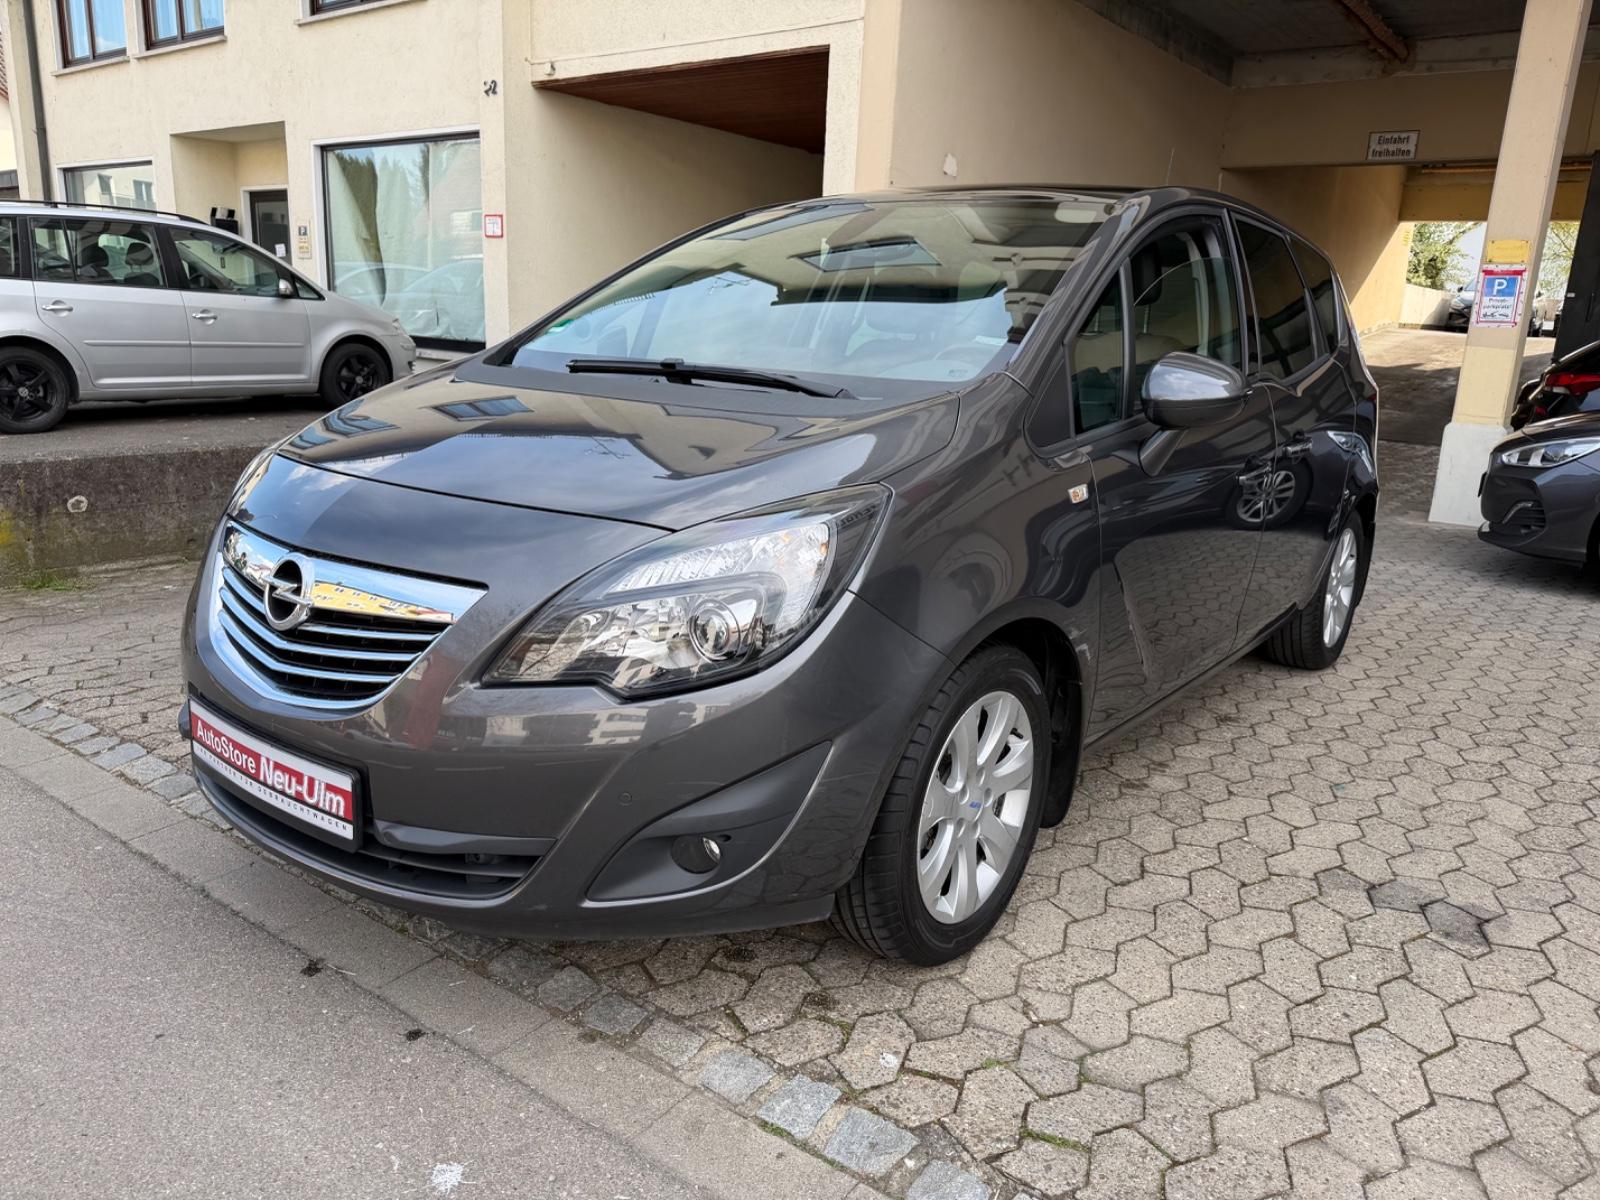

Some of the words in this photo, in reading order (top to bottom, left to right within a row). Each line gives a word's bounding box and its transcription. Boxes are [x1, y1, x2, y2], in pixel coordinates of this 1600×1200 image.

[1377, 135, 1410, 145] Einfahrt
[1371, 148, 1411, 158] freihalten
[1493, 279, 1507, 295] P
[197, 720, 257, 774] AutoStore
[260, 756, 345, 818] Neu-Ulm
